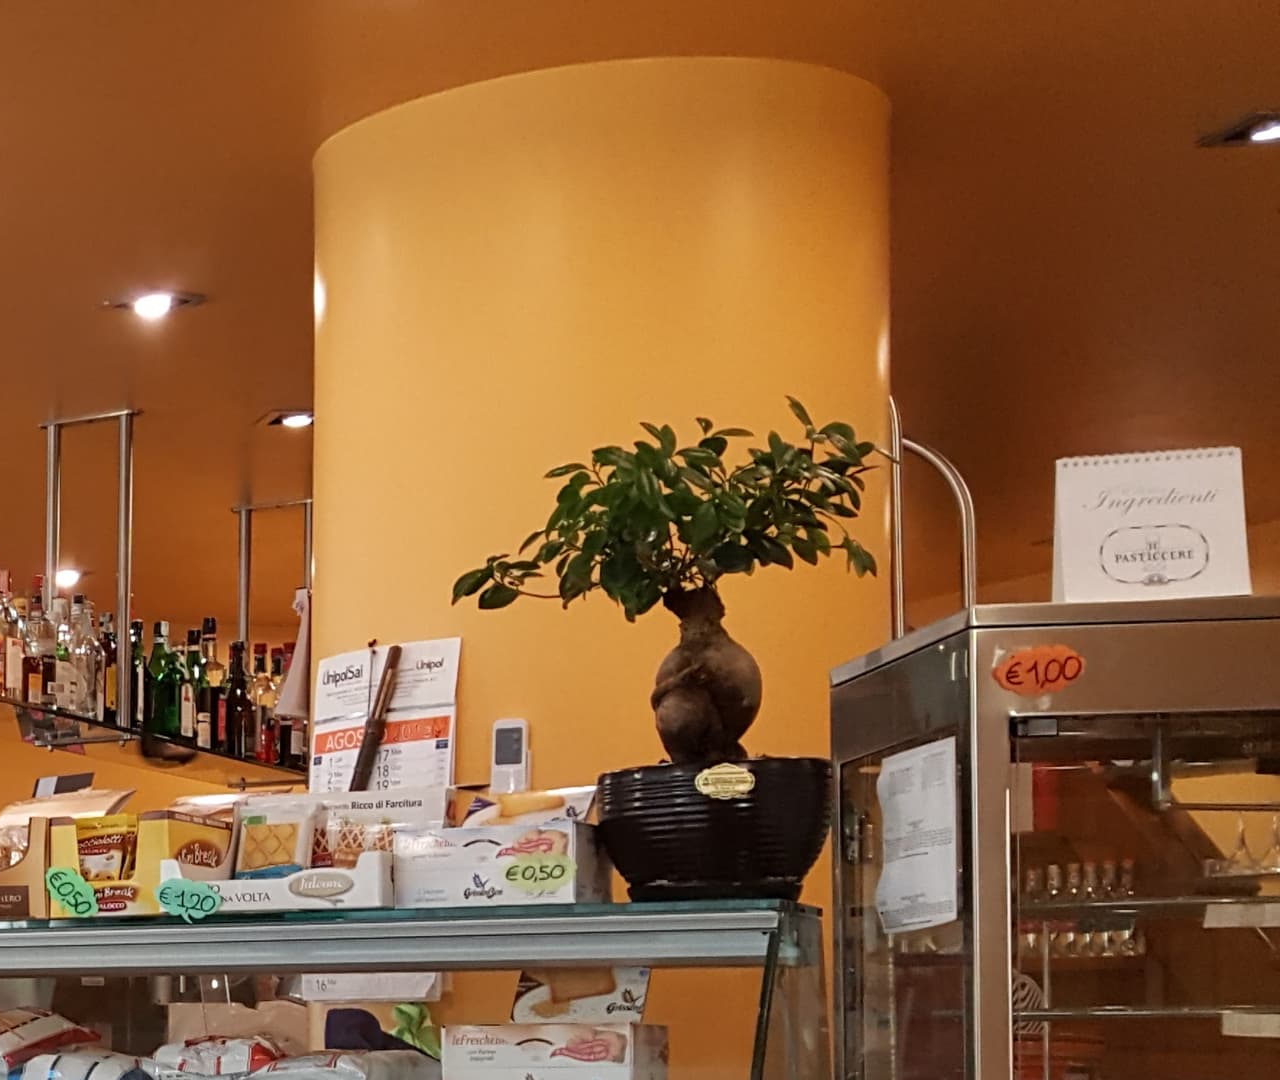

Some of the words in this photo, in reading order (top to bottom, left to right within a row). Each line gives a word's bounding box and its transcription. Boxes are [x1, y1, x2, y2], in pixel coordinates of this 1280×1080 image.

[1081, 487, 1217, 518] Ingredienti
[1114, 549, 1194, 564] PASTICCERE
[415, 657, 445, 673] Unipol
[322, 664, 364, 688] UnipolSai
[325, 728, 388, 752] AGOS
[376, 765, 389, 777] 18
[376, 780, 389, 791] 19
[351, 800, 373, 810] Ricco
[375, 800, 384, 809] di
[385, 799, 423, 808] Farcitura
[195, 843, 218, 868] Break
[103, 886, 135, 898] Break
[234, 891, 271, 903] VOLTA
[99, 902, 126, 910] ALOCCO
[315, 978, 327, 992] 16
